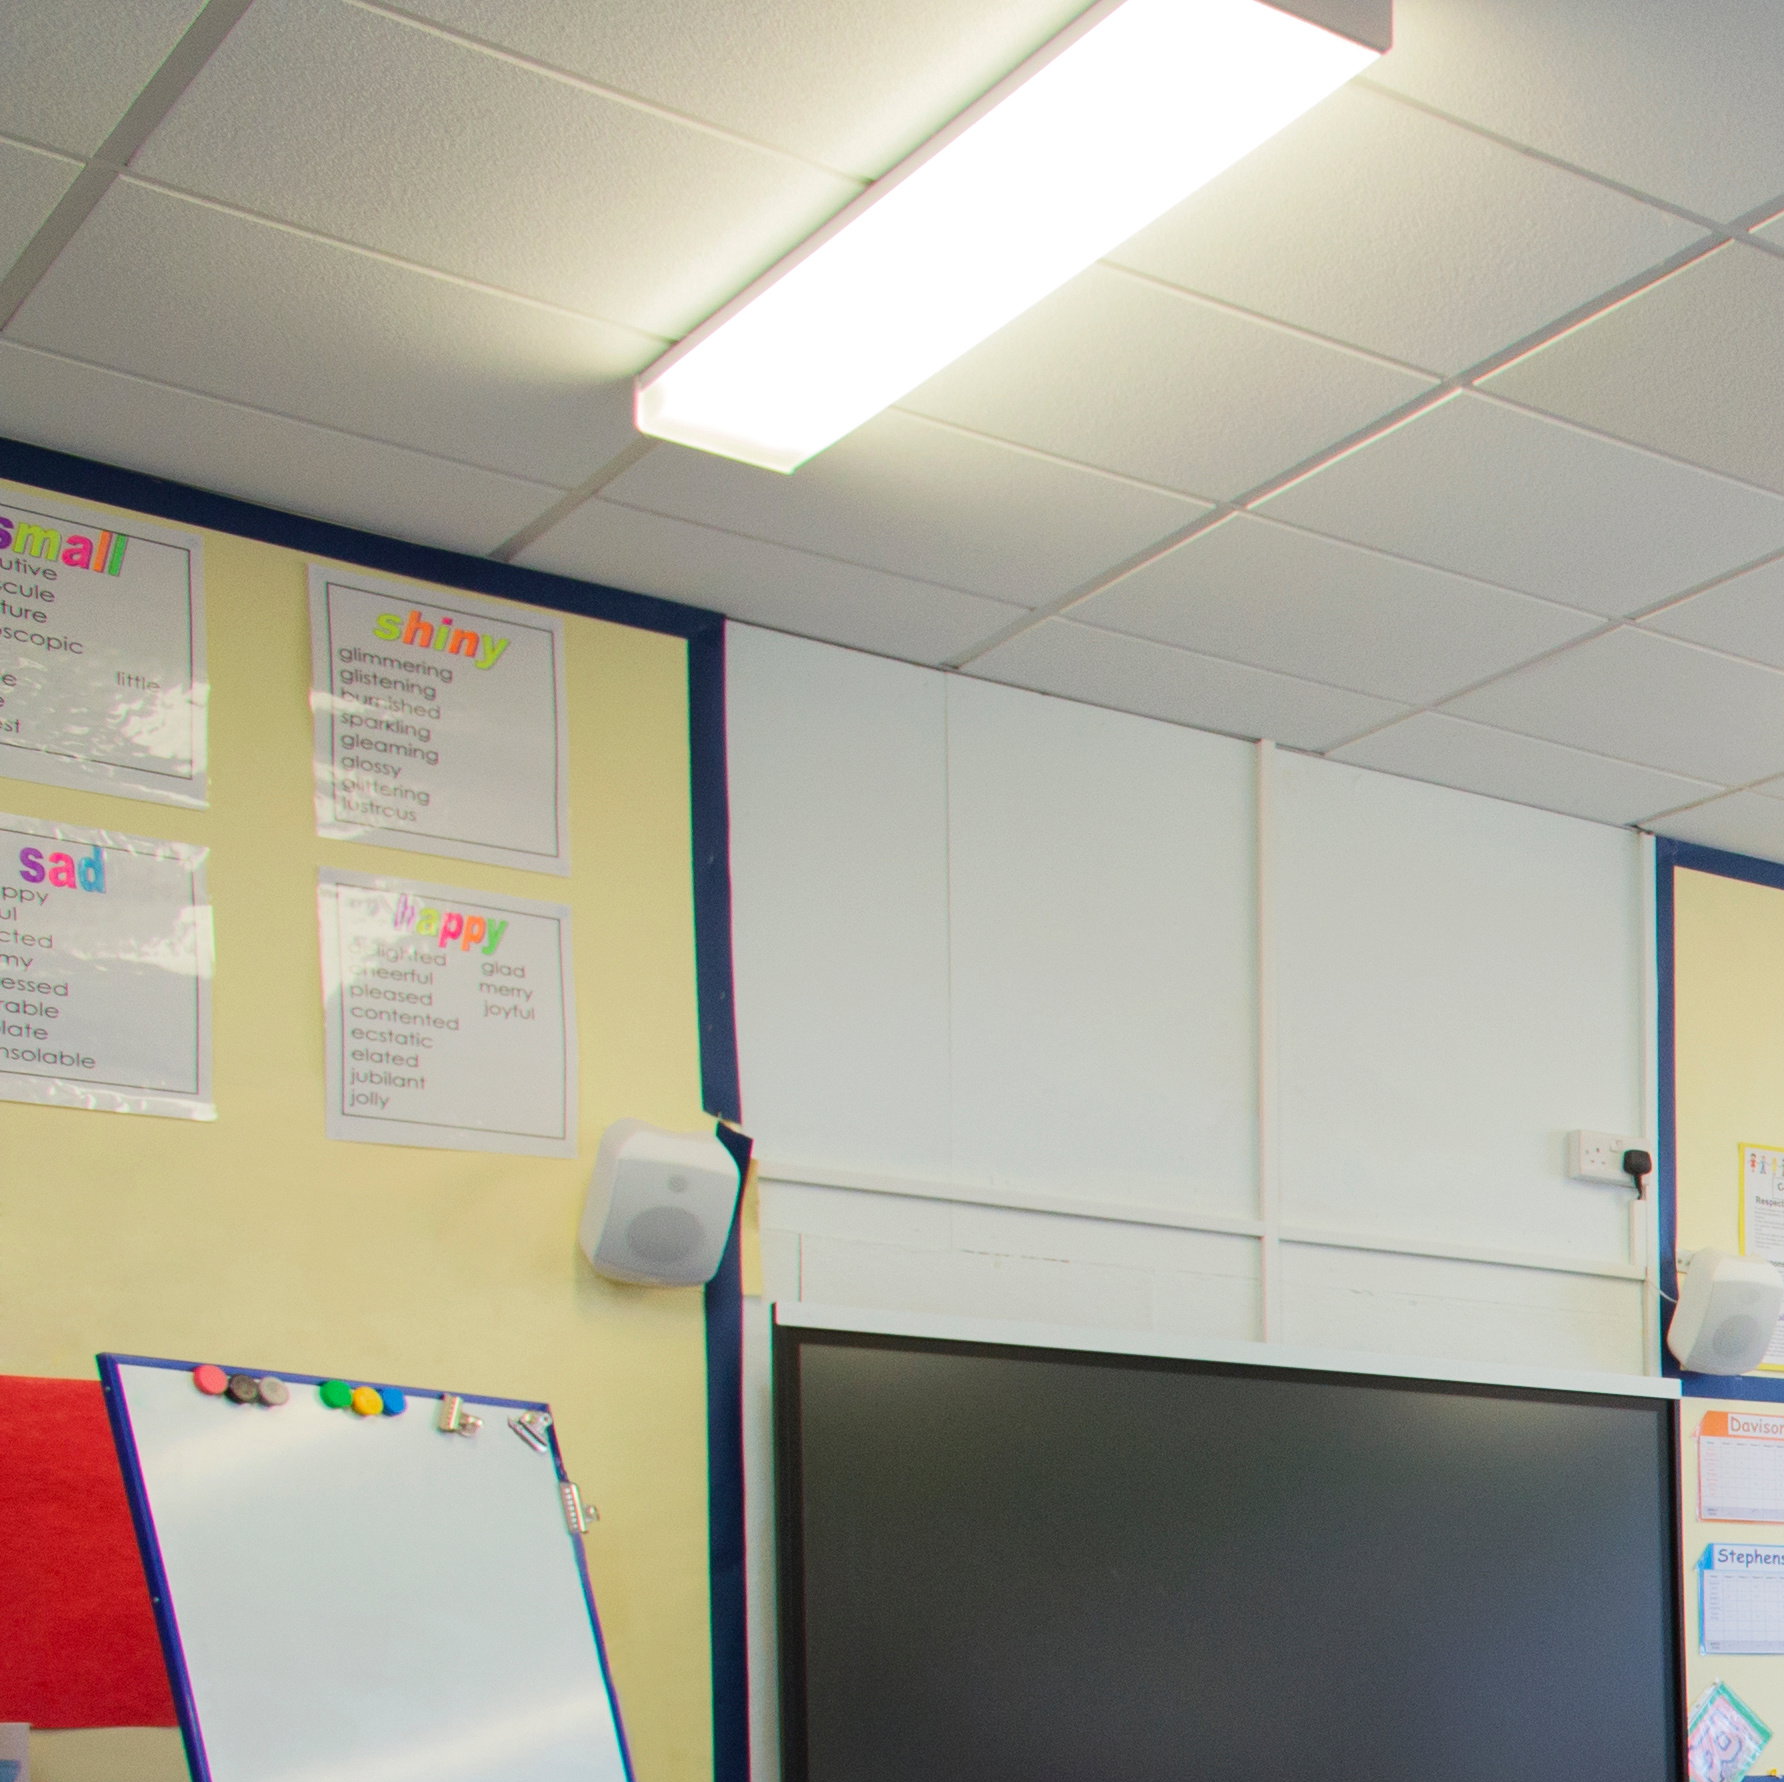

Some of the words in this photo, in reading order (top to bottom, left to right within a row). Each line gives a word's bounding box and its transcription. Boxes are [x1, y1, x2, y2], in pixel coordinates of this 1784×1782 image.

[372, 609, 510, 670] shiny
[339, 647, 453, 683] glimmering
[115, 671, 161, 690] little
[340, 668, 437, 700] glistening
[340, 712, 431, 742] sparkling
[340, 733, 439, 765] gleaming
[340, 755, 402, 779] glossy
[341, 776, 430, 806] glittering
[342, 796, 417, 822] lustrous
[19, 845, 106, 893] sad
[394, 893, 508, 955] happy
[352, 937, 447, 967] lighted
[481, 961, 526, 979] glad
[350, 984, 433, 1006] pleased
[479, 982, 534, 1001] merry
[351, 1005, 460, 1031] contented
[483, 1000, 537, 1021] joyful
[351, 1027, 433, 1049] ecstatic
[351, 1047, 420, 1068] elated
[350, 1068, 427, 1089] jubilant
[349, 1088, 391, 1110] jolly
[1755, 1196, 1784, 1208] Respect
